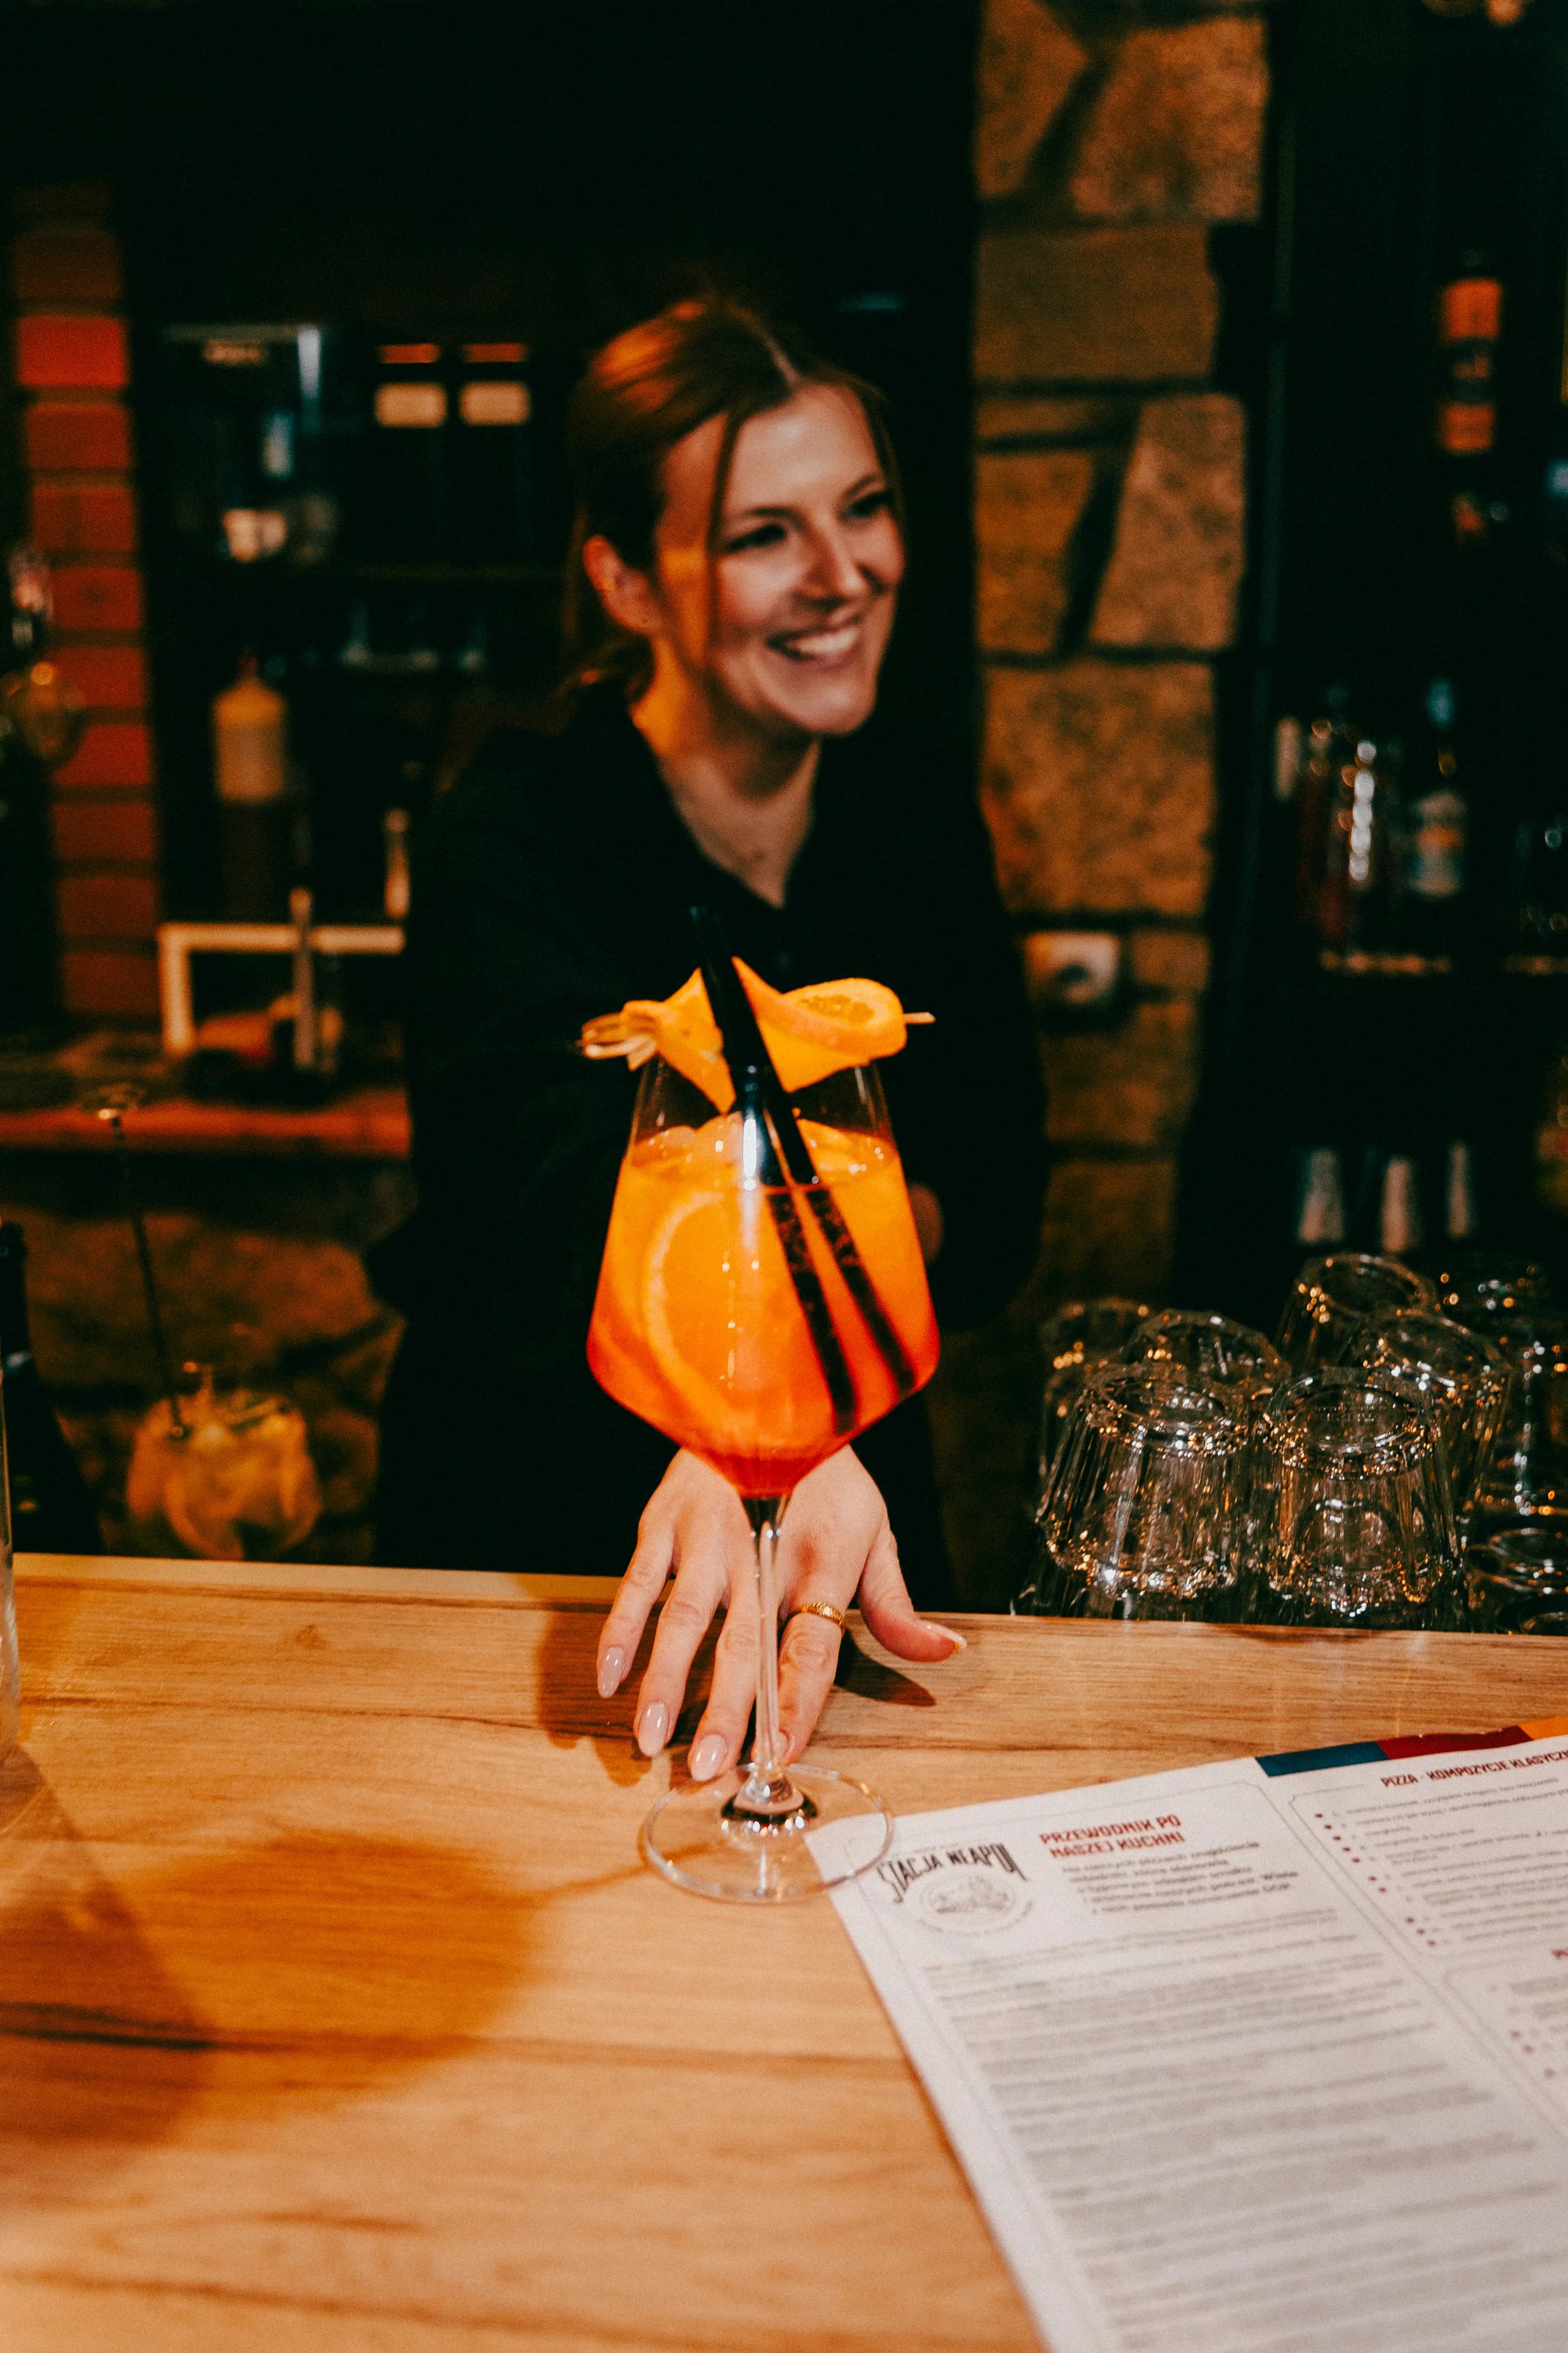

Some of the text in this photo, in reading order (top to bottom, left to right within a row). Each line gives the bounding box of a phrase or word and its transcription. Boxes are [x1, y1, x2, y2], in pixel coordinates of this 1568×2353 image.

[1381, 1774, 1419, 1787] PIZZA
[1426, 1760, 1511, 1780] KOMPOZYCJE
[1039, 1815, 1181, 1844] PRZEWODNIK PO
[1049, 1841, 1114, 1858] NASZEJ
[1116, 1831, 1185, 1850] KUCHNI
[876, 1854, 944, 1903] STACJA
